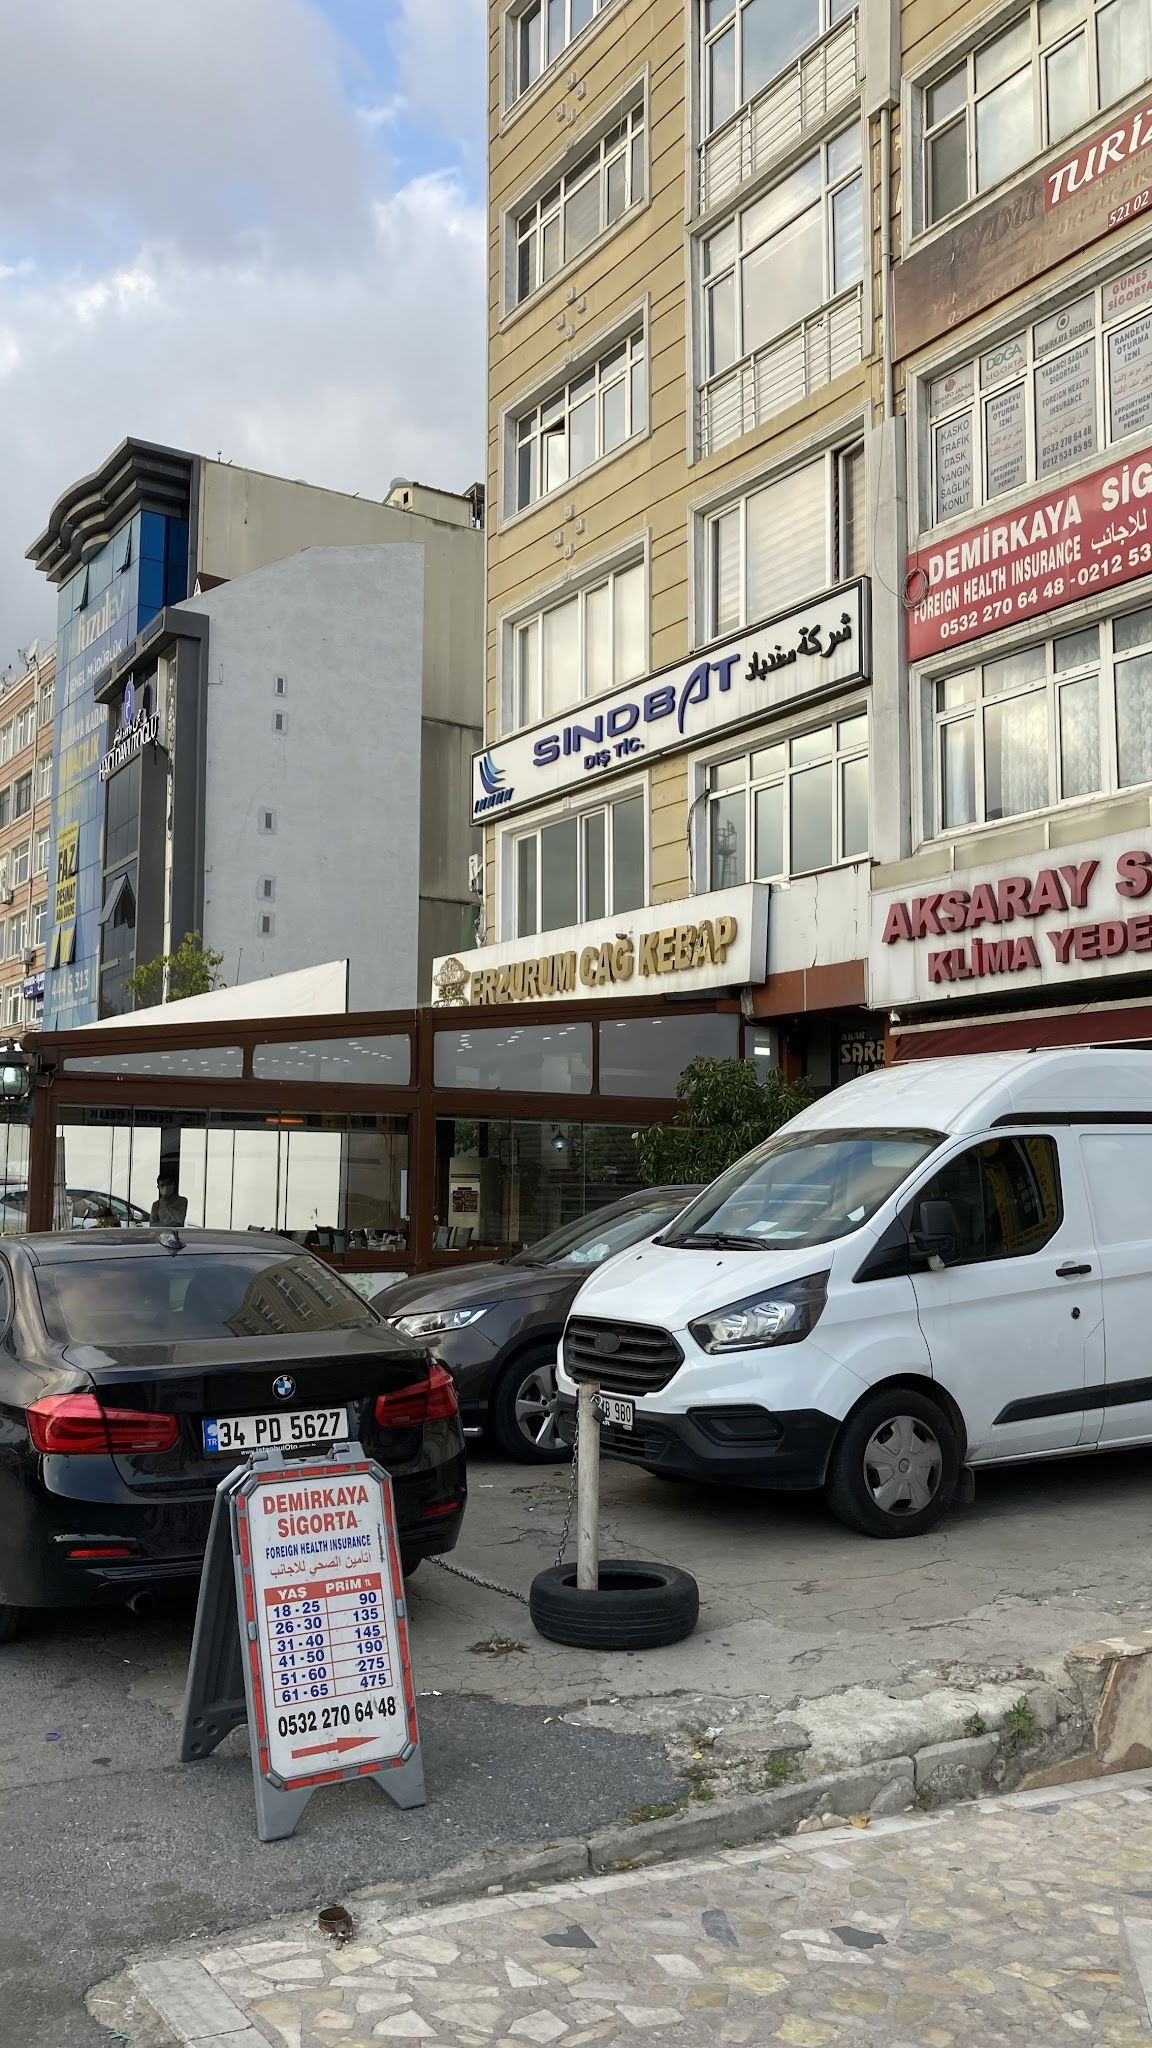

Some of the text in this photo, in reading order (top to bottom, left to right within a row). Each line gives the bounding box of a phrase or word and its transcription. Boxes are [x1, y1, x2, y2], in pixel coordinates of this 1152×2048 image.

[1108, 190, 1150, 228] 521 02
[1114, 321, 1151, 346] RANDEVU
[1116, 332, 1149, 355] OTURMA
[991, 391, 1021, 412] RANDEVU
[1042, 388, 1067, 408] FOREIGN
[993, 402, 1020, 421] OTURMA
[940, 420, 970, 442] KASKO
[940, 434, 970, 456] TRAFİK
[1042, 441, 1059, 457] 0532
[944, 450, 967, 469] DASK
[1042, 455, 1058, 470] 0212
[941, 463, 971, 484] YANGIN
[942, 492, 970, 513] KONUT
[928, 494, 1082, 586] DEMİRKAYA
[914, 535, 1082, 625] FOREIGN HEALTH INSURANCE
[940, 610, 978, 639] 0532
[982, 597, 1013, 623] 270
[1017, 587, 1038, 609] 64
[1042, 577, 1065, 598] 48
[1128, 542, 1152, 567] 53
[745, 612, 852, 681] شركة سندباد
[583, 749, 612, 770] DIŞ
[881, 860, 1100, 944] AKSARAY
[471, 950, 576, 1005] ERZURUM
[638, 915, 738, 977] KEBAP
[928, 936, 1041, 983] KLİMA
[614, 1402, 631, 1423] 980
[207, 1411, 340, 1448] TR 34 PD 5627
[262, 1484, 369, 1515] DEMİRKAYA
[277, 1510, 359, 1538] SİGORTA
[265, 1534, 371, 1560] FOREIGN HEALTH INSURANCE
[277, 1586, 307, 1601] YAŞ
[364, 1578, 372, 1587] TL
[359, 1592, 377, 1605] 90
[353, 1608, 379, 1622] 135
[355, 1625, 381, 1639] 145
[357, 1640, 383, 1655] 190
[358, 1657, 385, 1672] 275
[360, 1673, 387, 1689] 475
[278, 1696, 397, 1738] 0532 270 64 48
